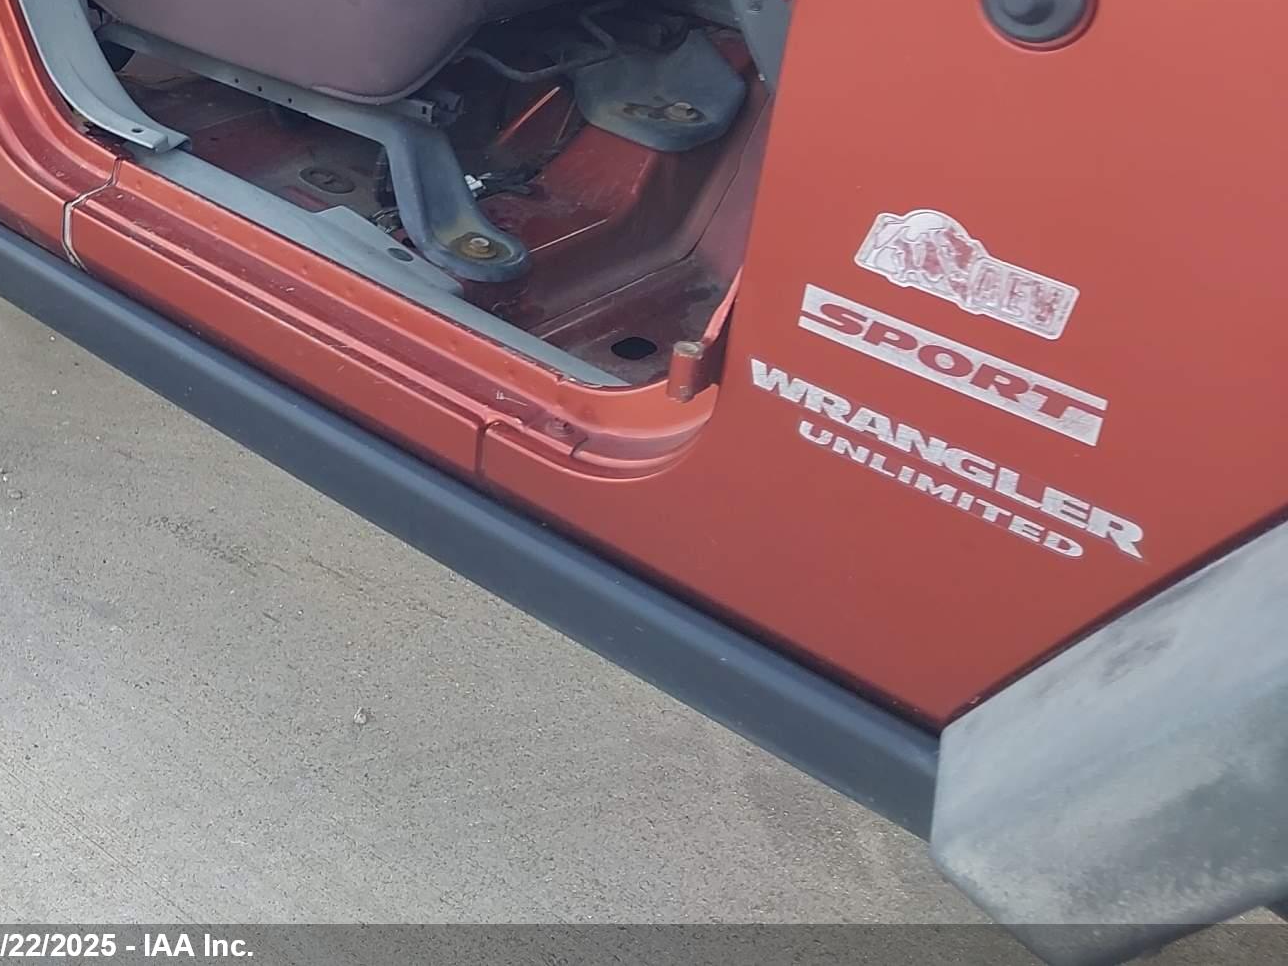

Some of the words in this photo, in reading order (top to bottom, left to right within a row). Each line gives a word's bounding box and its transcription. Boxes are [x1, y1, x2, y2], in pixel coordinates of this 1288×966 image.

[818, 302, 1082, 420] SPORT
[750, 359, 1143, 560] WRANGLER
[797, 419, 1084, 558] UNLIMITED
